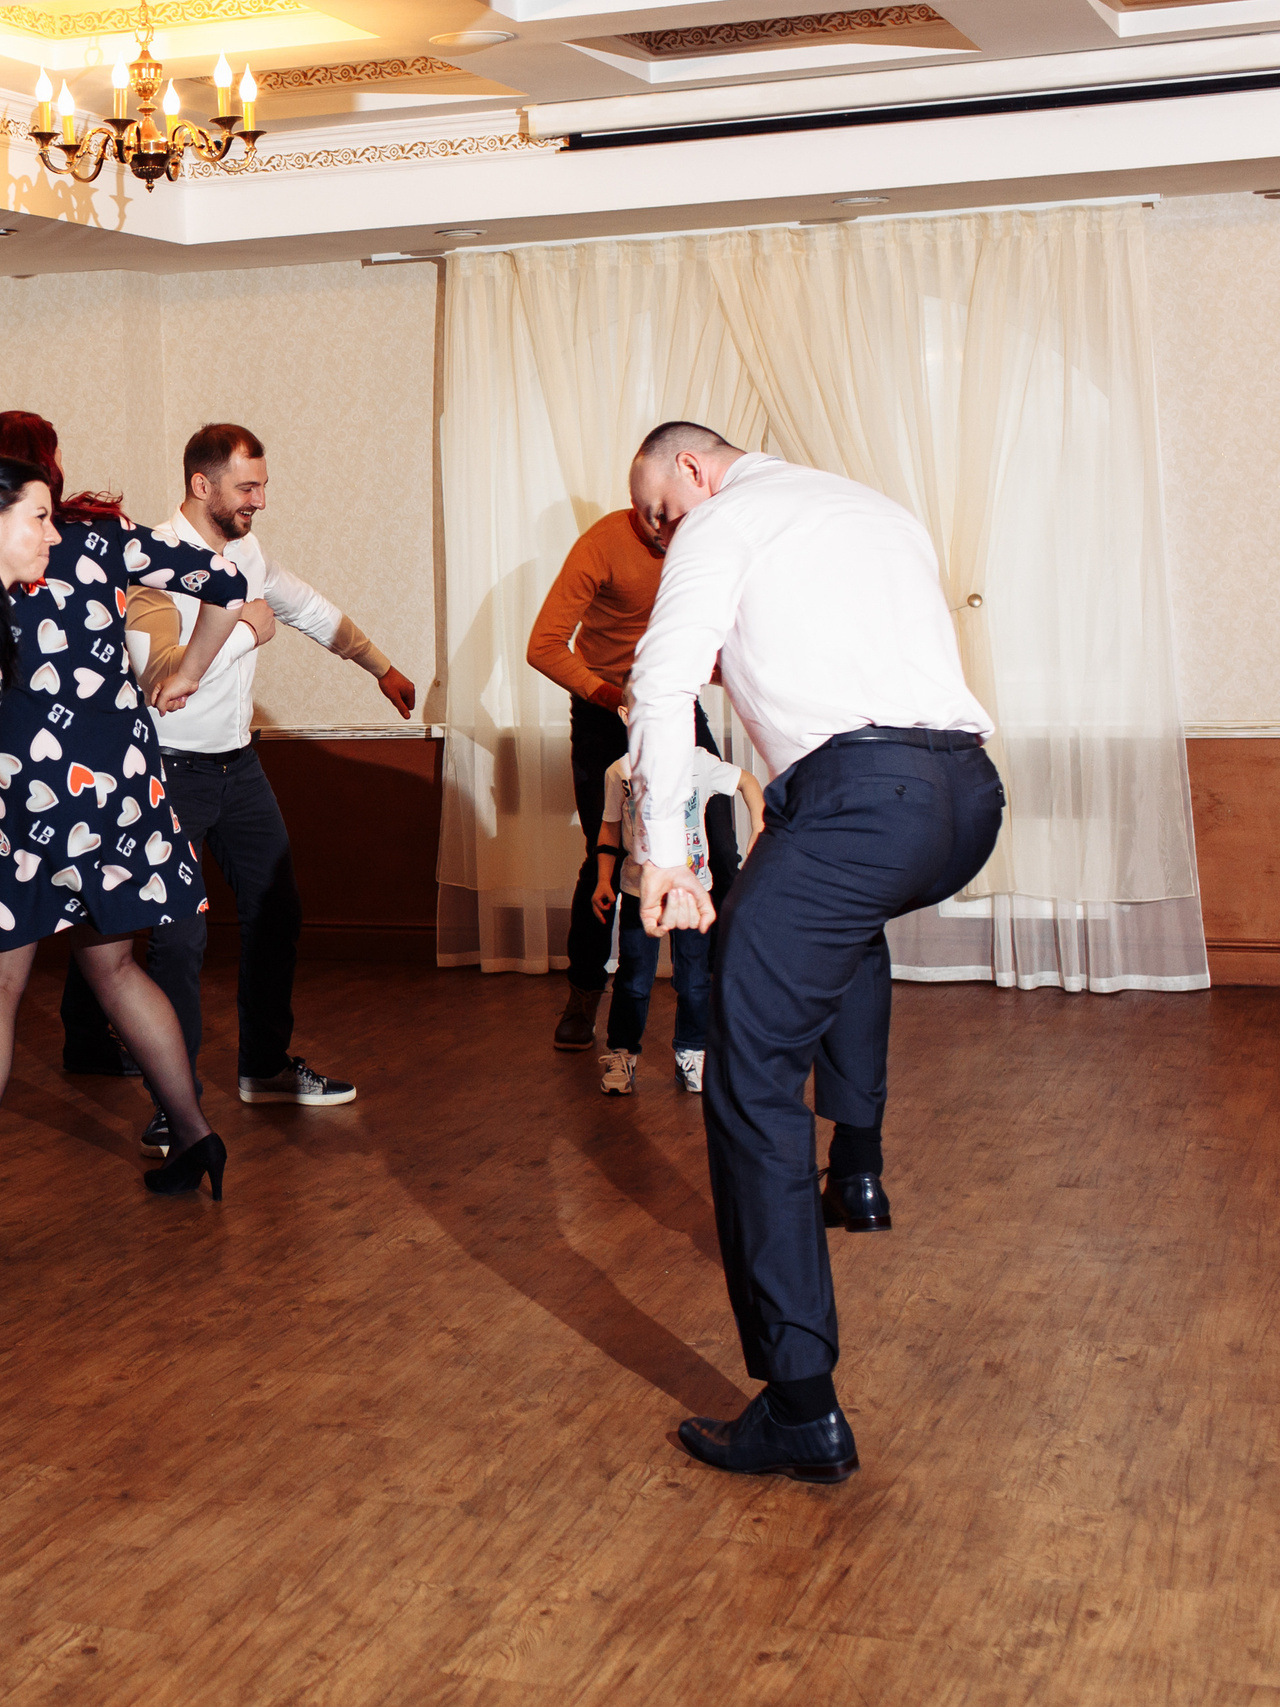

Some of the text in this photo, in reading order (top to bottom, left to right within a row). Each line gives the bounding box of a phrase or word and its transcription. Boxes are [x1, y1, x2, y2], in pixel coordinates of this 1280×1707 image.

[90, 637, 115, 664] LB
[28, 819, 56, 845] LB
[115, 832, 137, 858] LB
